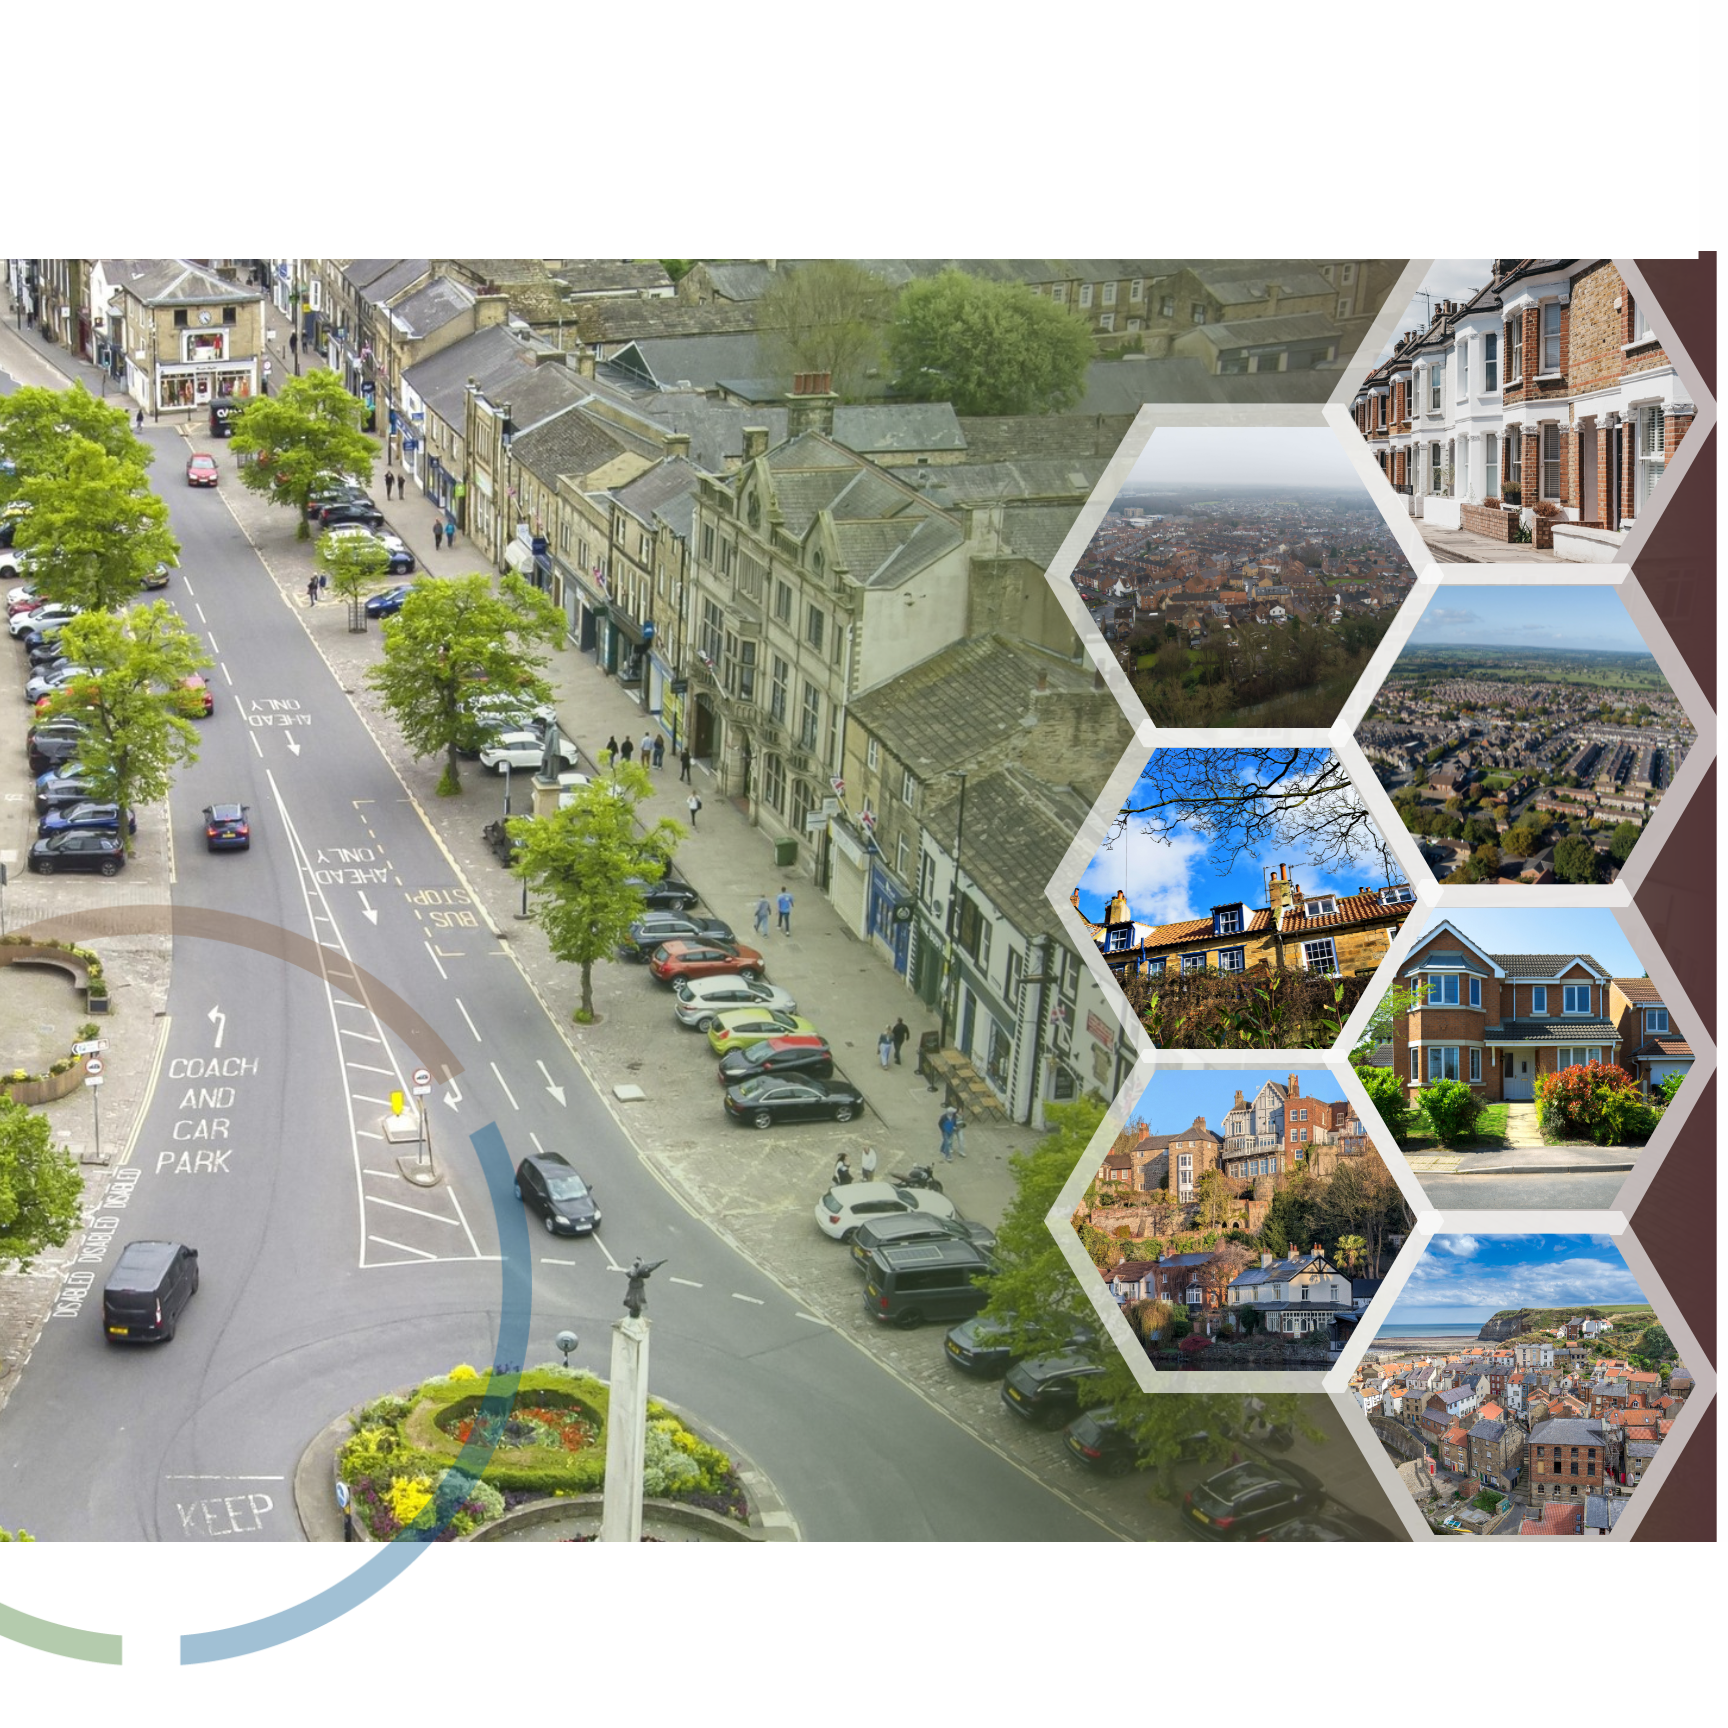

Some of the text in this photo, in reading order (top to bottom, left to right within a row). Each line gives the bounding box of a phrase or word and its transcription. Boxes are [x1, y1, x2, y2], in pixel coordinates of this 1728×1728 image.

[251, 699, 301, 711] ONLY
[248, 714, 311, 726] AHEAD
[317, 848, 375, 863] ONLY
[315, 868, 387, 885] AHEAD
[413, 888, 472, 905] STOP
[429, 910, 479, 928] BUS
[168, 1057, 260, 1079] COACH
[178, 1087, 236, 1109] AND
[173, 1117, 230, 1140] CAR
[155, 1149, 233, 1174] PARK
[103, 1168, 142, 1209] DISABLED
[77, 1216, 120, 1263] DISABLED
[52, 1271, 95, 1318] DISABLED
[176, 1493, 274, 1536] KEEP
